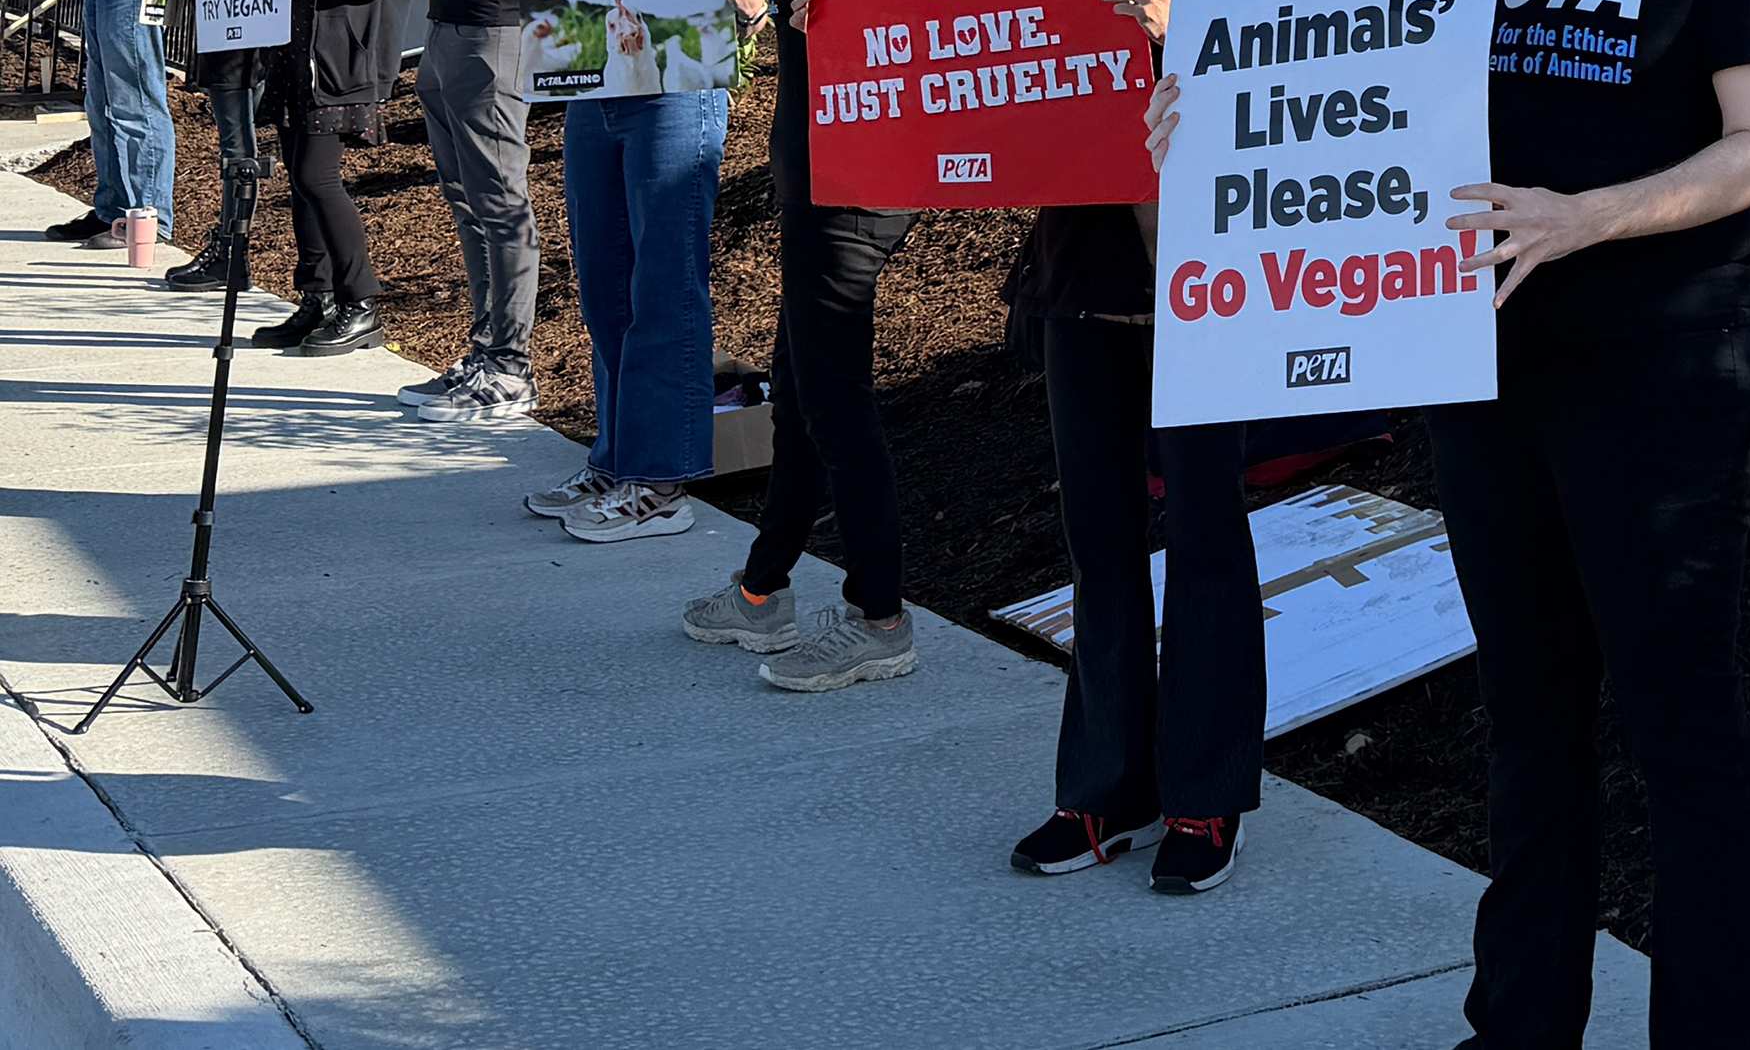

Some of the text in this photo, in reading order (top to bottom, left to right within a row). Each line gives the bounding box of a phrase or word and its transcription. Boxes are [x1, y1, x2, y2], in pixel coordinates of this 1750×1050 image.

[863, 6, 1062, 68] NO LOVE.
[1495, 22, 1638, 58] for the Ethical
[1523, 52, 1545, 75] of
[1547, 56, 1632, 85] Animals
[816, 49, 1147, 125] JUST CRUELTY.
[1234, 85, 1408, 150] Lives.
[1214, 166, 1429, 235] Please,
[1168, 230, 1479, 322] Go Vegan!
